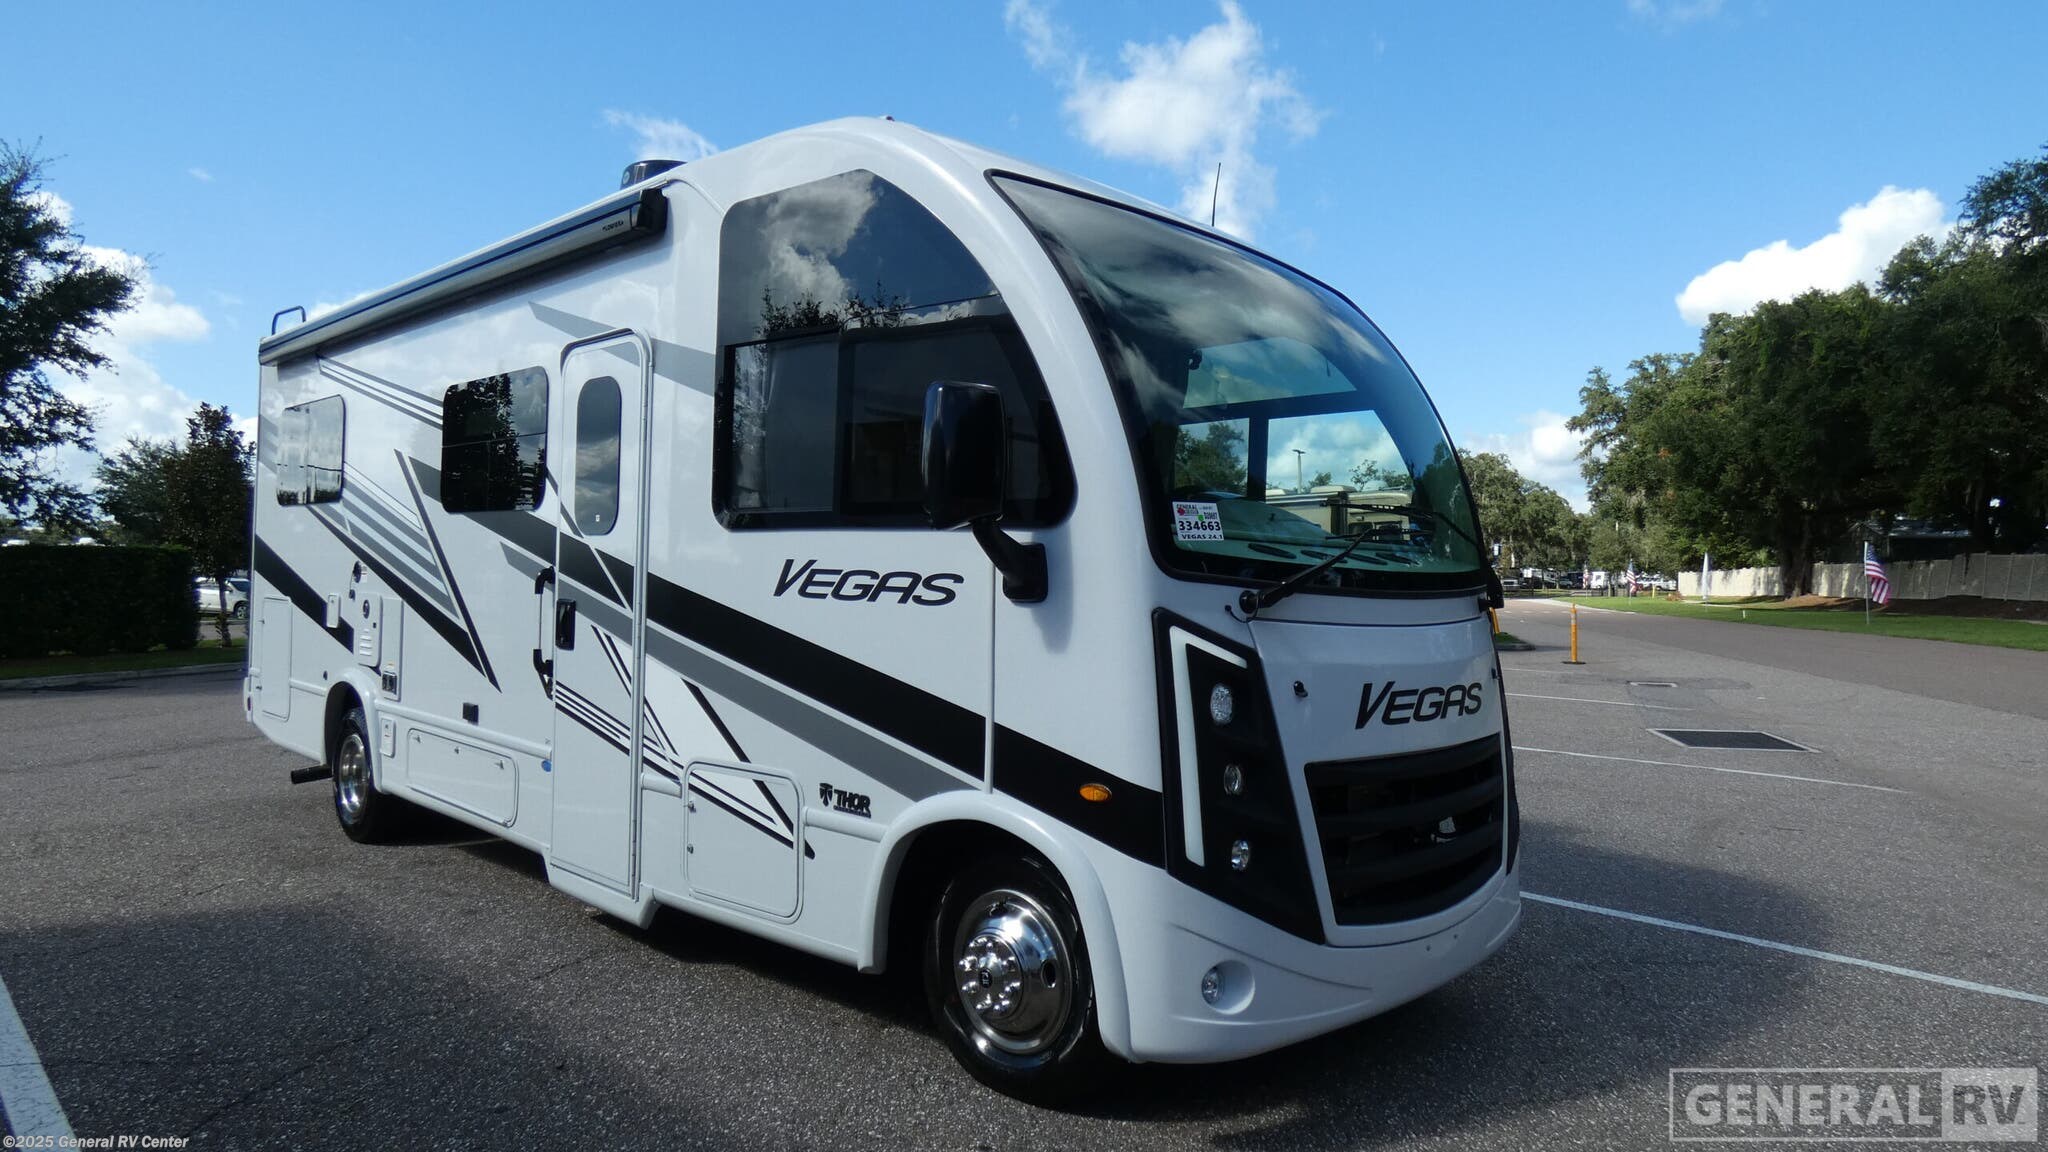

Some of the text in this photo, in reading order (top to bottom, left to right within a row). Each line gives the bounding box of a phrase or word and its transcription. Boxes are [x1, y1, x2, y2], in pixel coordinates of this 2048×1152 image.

[1179, 521, 1221, 531] 334663
[773, 559, 964, 606] VEGAS
[1355, 681, 1482, 729] VEGAS
[834, 789, 871, 815] THOR
